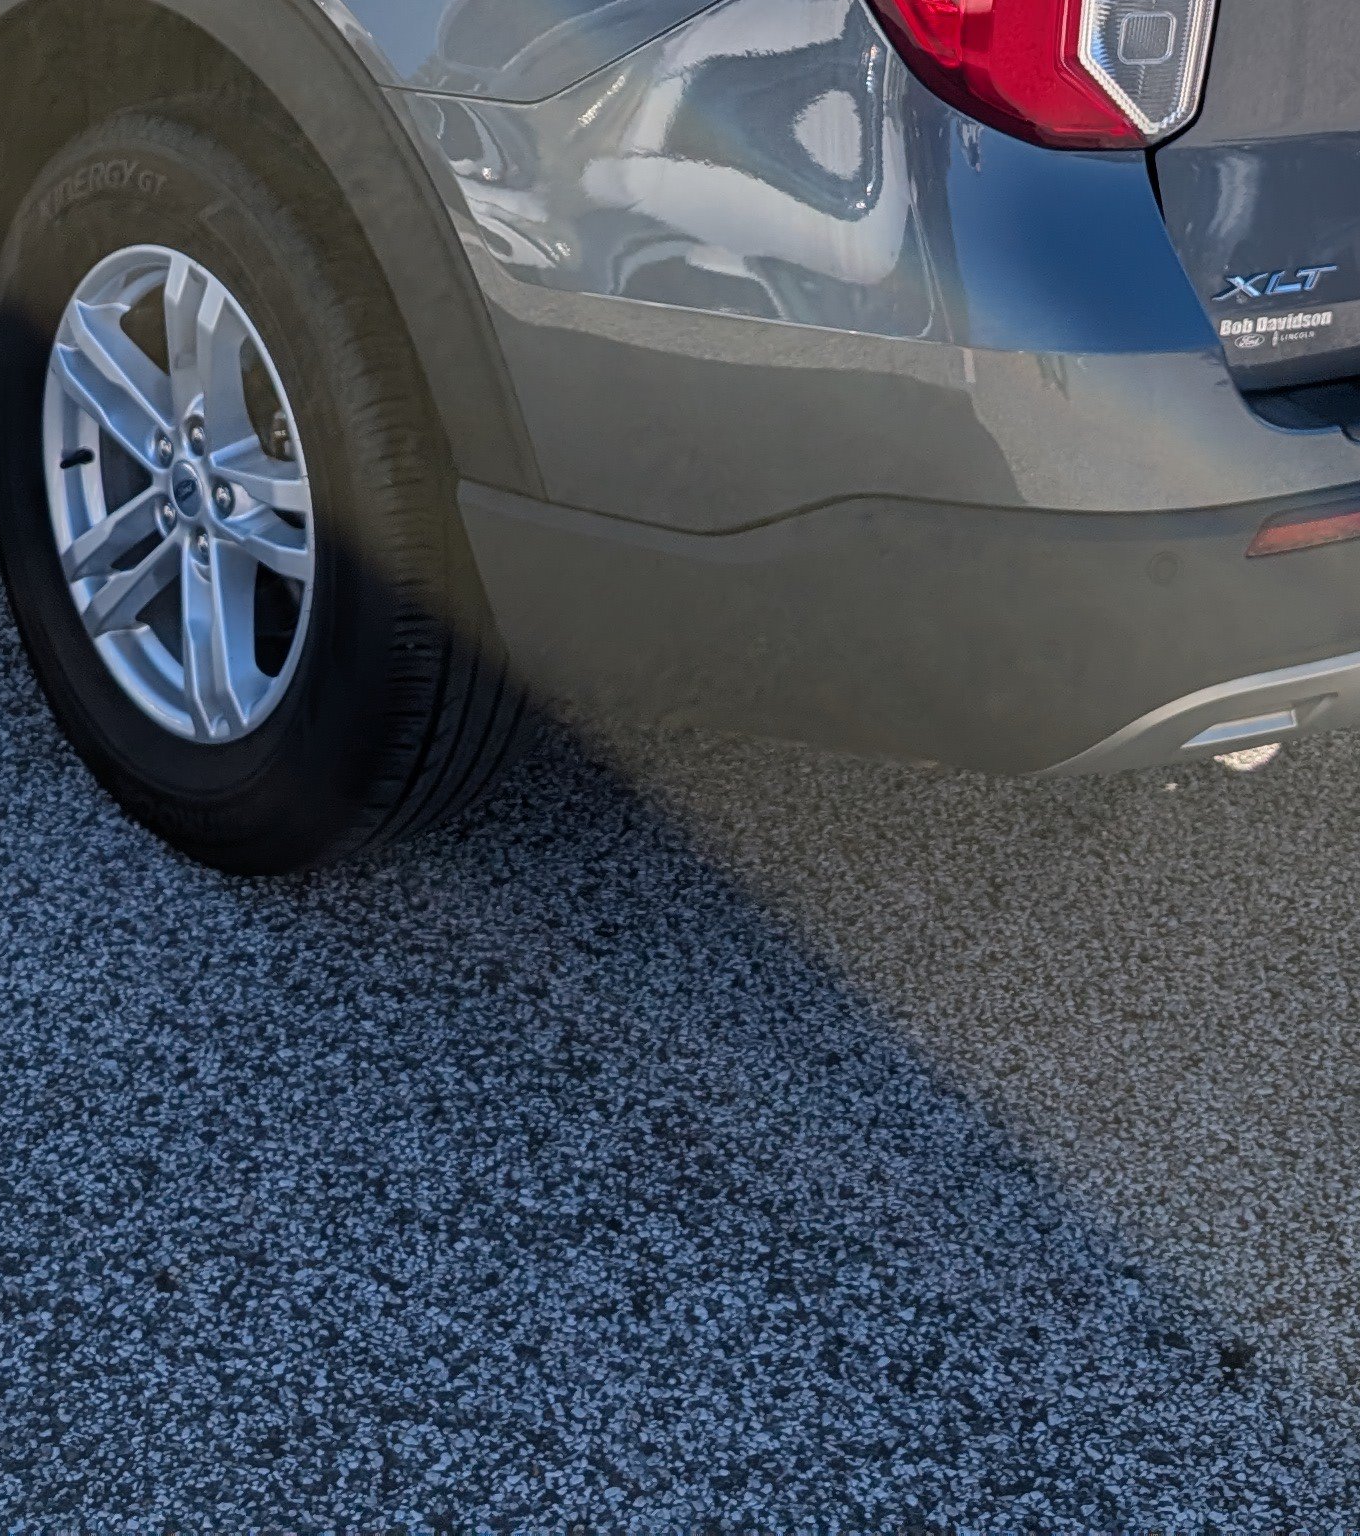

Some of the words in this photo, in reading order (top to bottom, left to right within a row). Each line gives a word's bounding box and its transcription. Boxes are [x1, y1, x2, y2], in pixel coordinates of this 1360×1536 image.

[1211, 264, 1338, 302] XLT
[1220, 317, 1254, 337] Bob
[1255, 310, 1333, 333] Davidson
[1281, 330, 1315, 342] LINCOLN
